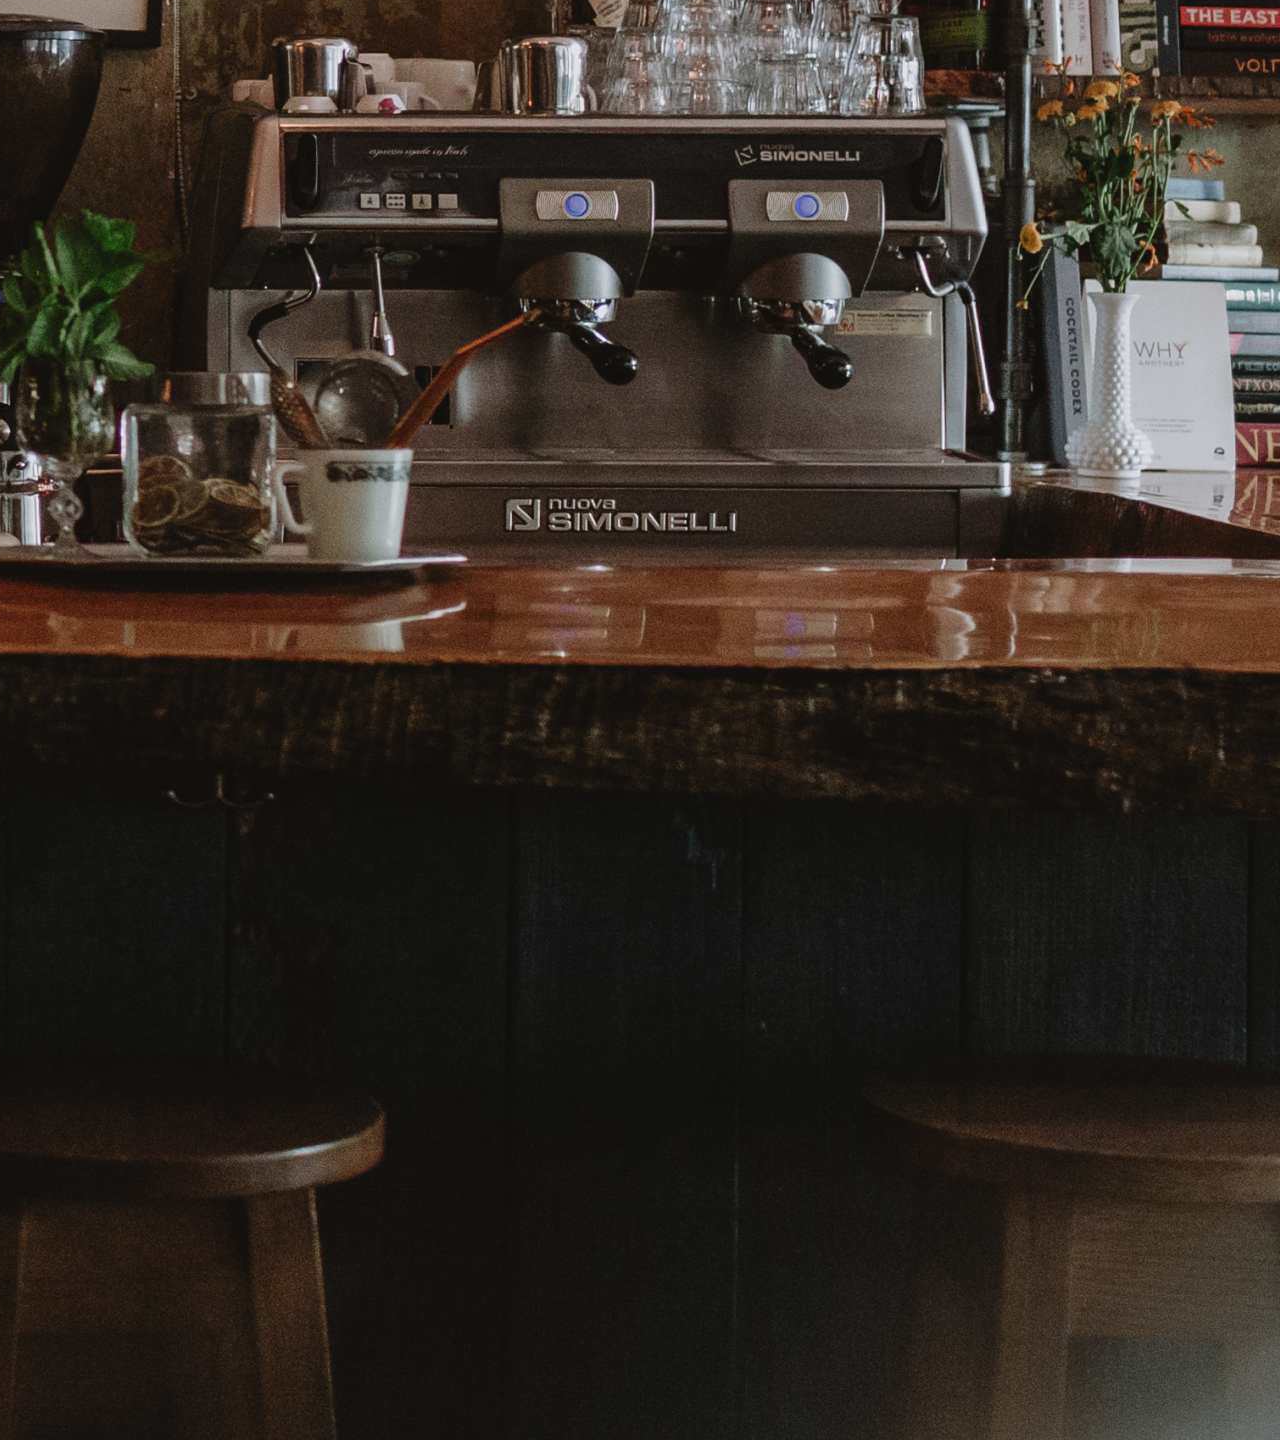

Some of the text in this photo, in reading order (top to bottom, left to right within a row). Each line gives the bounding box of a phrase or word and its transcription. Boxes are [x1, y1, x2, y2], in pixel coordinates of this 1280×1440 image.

[1186, 8, 1280, 25] THE EAST
[759, 150, 861, 162] SIMONELLI
[1064, 297, 1083, 417] COCKTAIL CODEX
[1133, 341, 1189, 359] WHY
[548, 498, 617, 511] nuova
[547, 511, 738, 533] SIMONELLI
